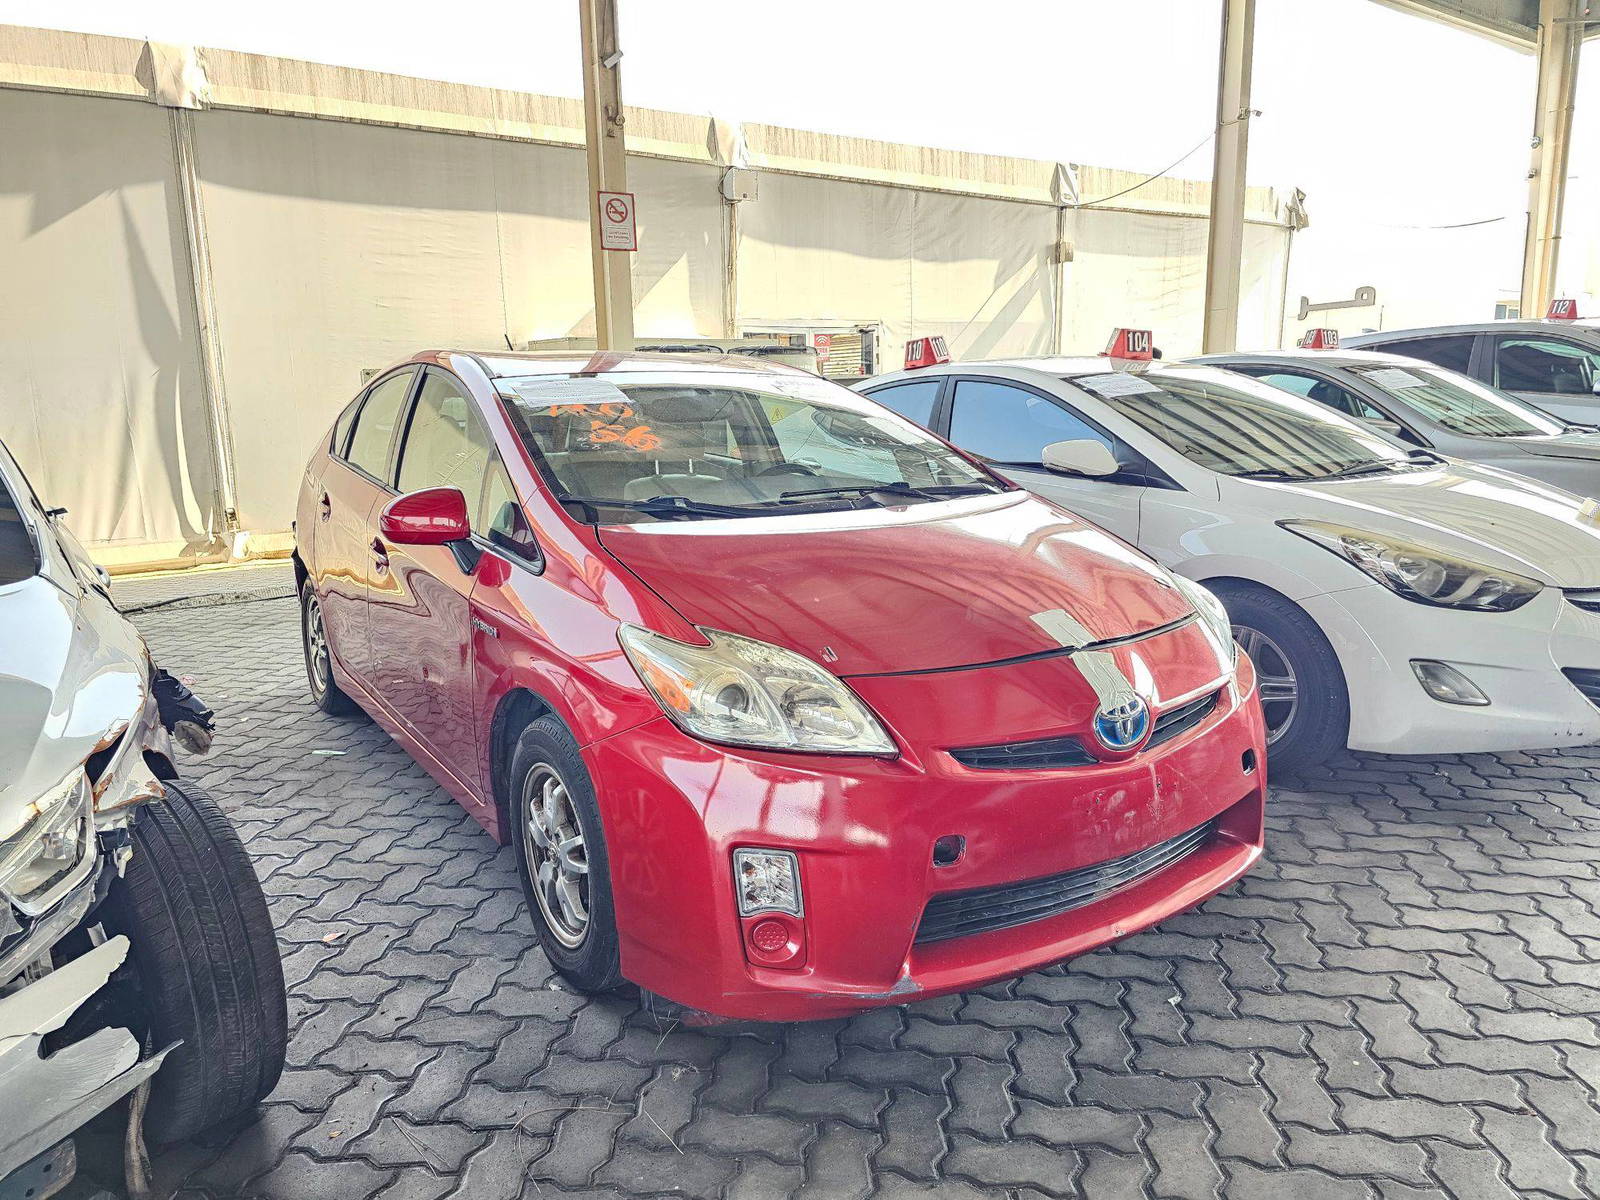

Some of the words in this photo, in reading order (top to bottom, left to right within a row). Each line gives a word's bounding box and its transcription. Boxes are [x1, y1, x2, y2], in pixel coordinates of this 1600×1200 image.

[1551, 300, 1569, 314] 112
[1128, 331, 1149, 352] 104
[1323, 330, 1338, 345] 103
[907, 340, 923, 361] 110
